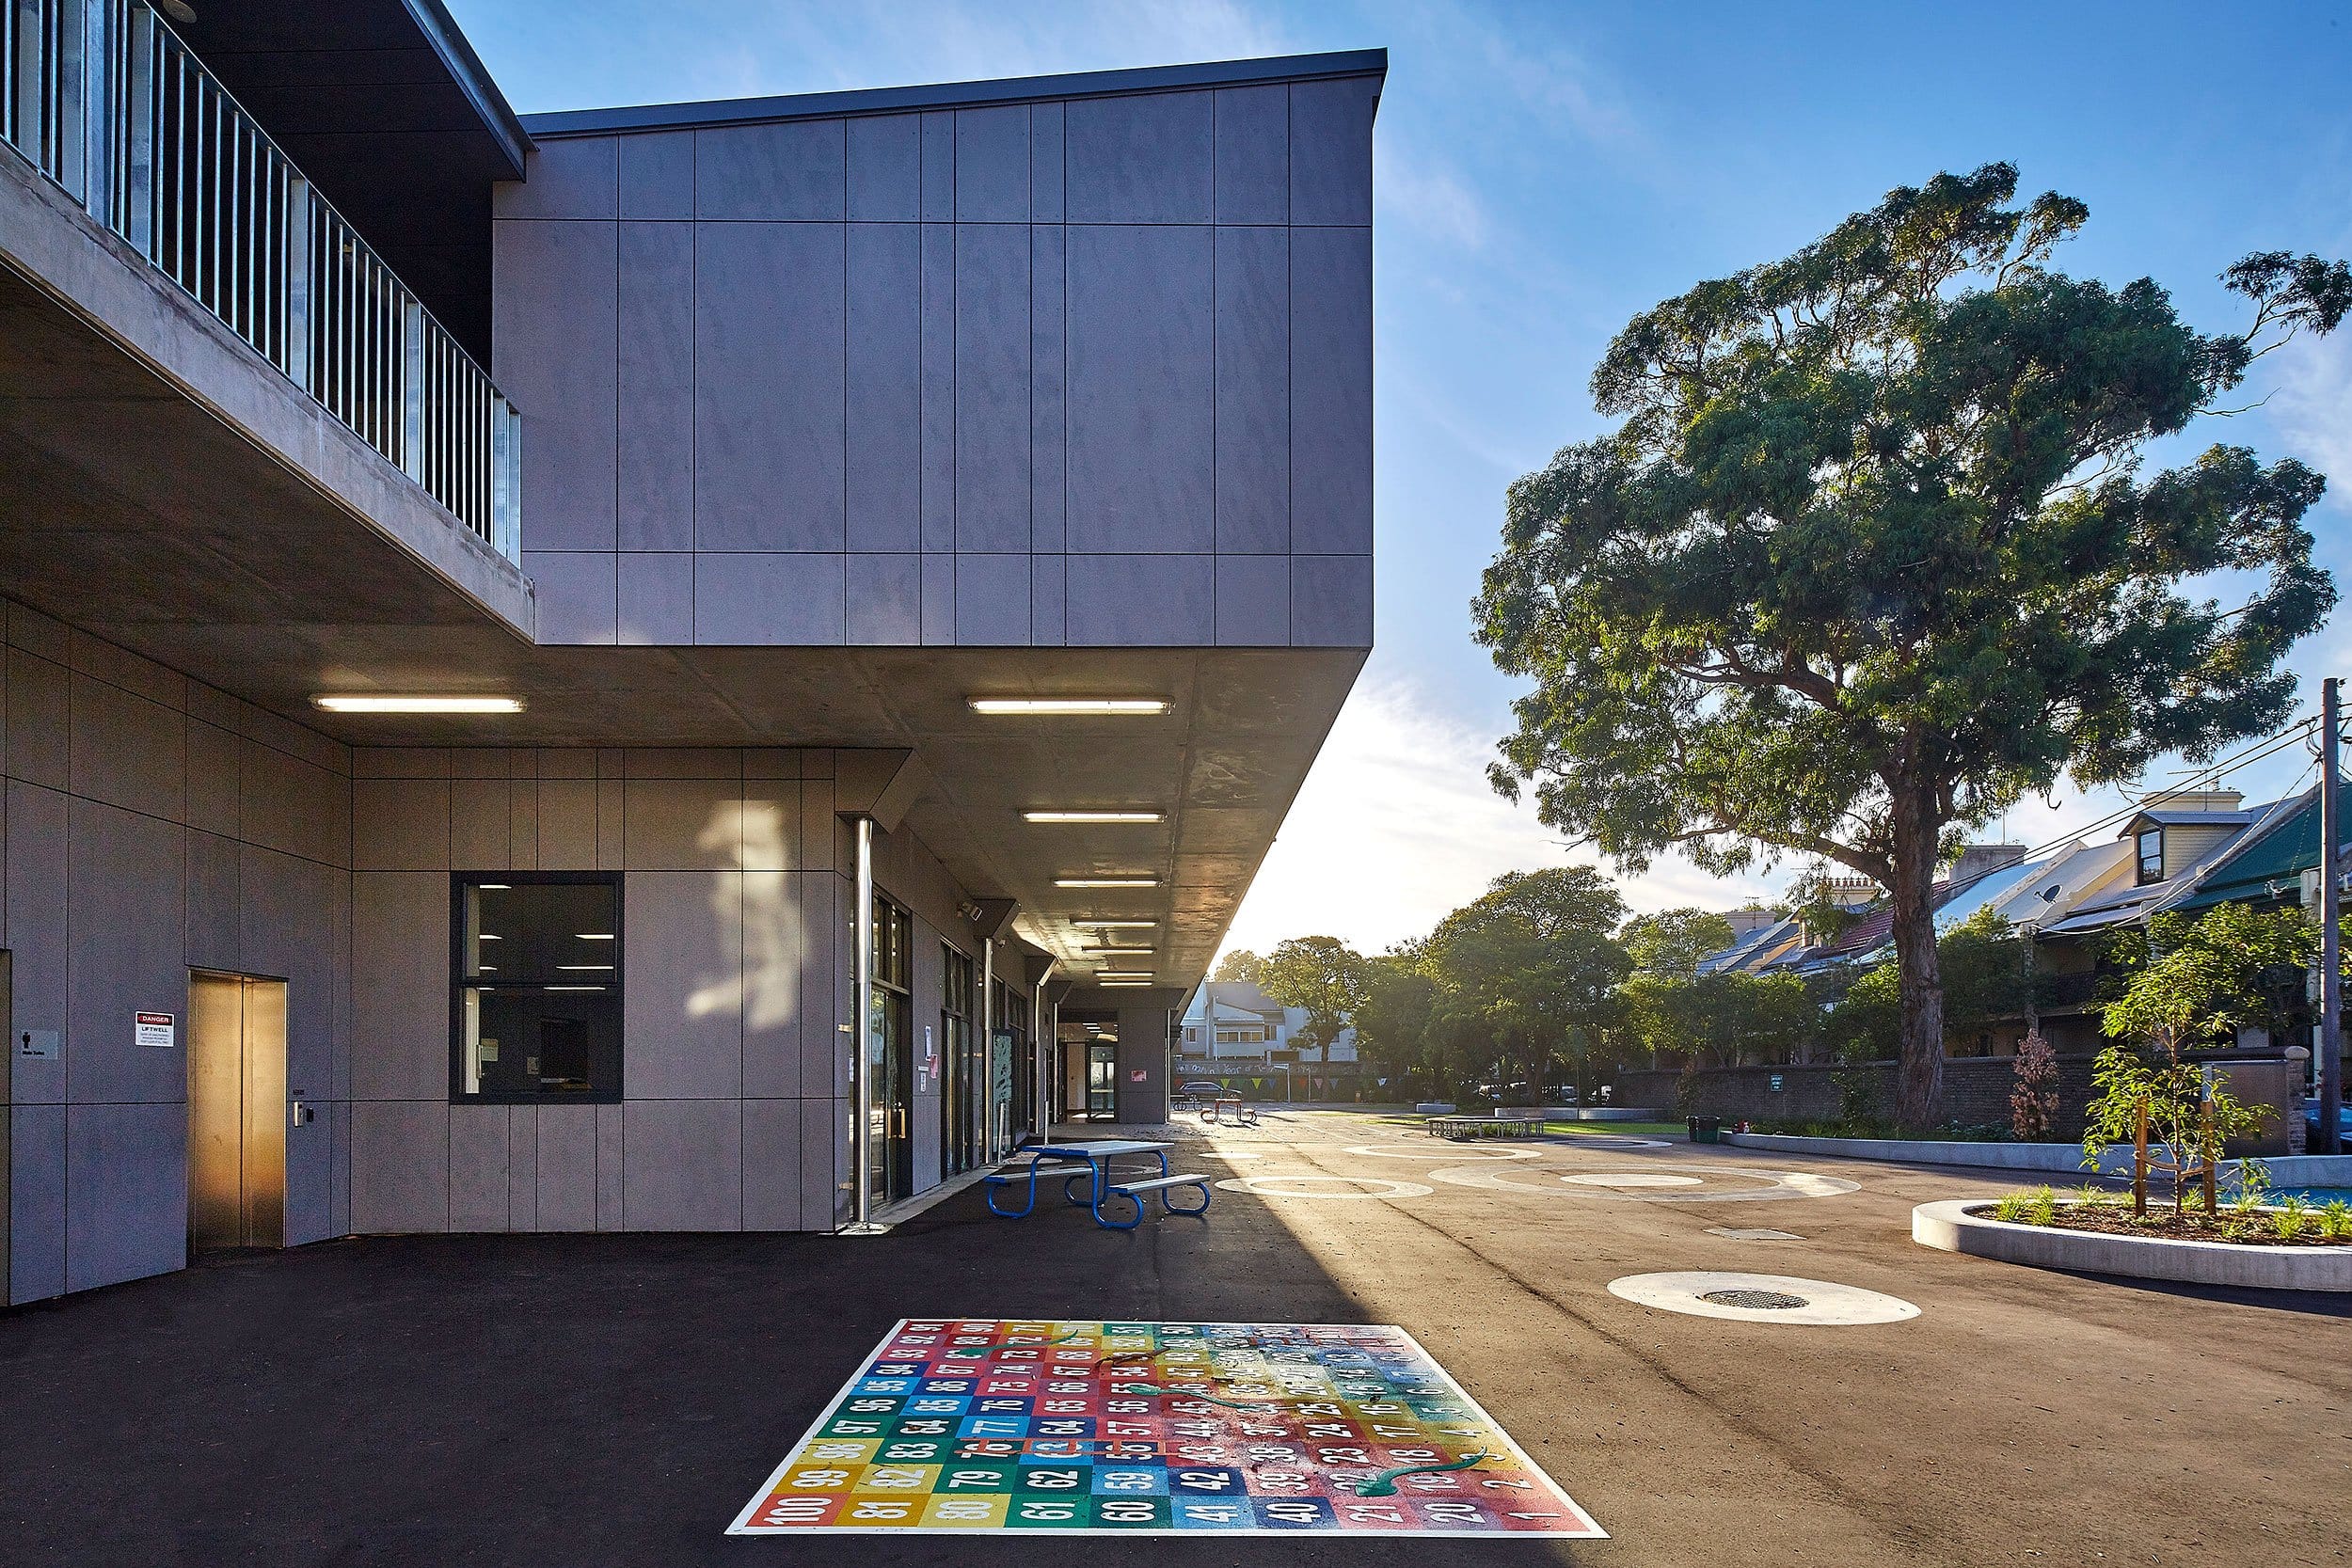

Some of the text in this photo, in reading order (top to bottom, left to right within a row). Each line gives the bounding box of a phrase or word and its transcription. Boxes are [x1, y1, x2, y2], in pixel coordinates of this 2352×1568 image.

[142, 1015, 169, 1023] DANGER
[1161, 1326, 1194, 1335] 50
[899, 1336, 936, 1344] 92
[888, 1350, 928, 1358] 93
[1001, 1351, 1039, 1360] 73
[1164, 1353, 1200, 1361] 48
[875, 1365, 917, 1375] 94
[935, 1365, 975, 1374] 87
[993, 1366, 1033, 1374] 74
[1053, 1366, 1090, 1375] 67
[1111, 1367, 1149, 1377] 54
[1167, 1368, 1204, 1377] 47
[926, 1381, 968, 1392] 86
[988, 1382, 1029, 1392] 75
[1048, 1382, 1089, 1393] 66
[1229, 1384, 1270, 1395] 35
[1287, 1385, 1328, 1396] 26
[1344, 1386, 1387, 1395] 15
[849, 1400, 897, 1411] 96
[914, 1400, 960, 1411] 85
[980, 1400, 1024, 1411] 76
[1044, 1401, 1087, 1412] 65
[1107, 1401, 1149, 1413] 56
[1172, 1402, 1213, 1415] 45
[1296, 1403, 1342, 1416] 25
[1358, 1403, 1402, 1415] 16
[832, 1420, 881, 1433] 97
[899, 1420, 949, 1434] 84
[971, 1420, 1018, 1433] 77
[1038, 1420, 1085, 1434] 64
[1107, 1421, 1152, 1435] 57
[1175, 1422, 1219, 1437] 44
[1241, 1422, 1288, 1437] 37
[1304, 1424, 1353, 1437] 24
[1372, 1424, 1421, 1437] 17
[813, 1443, 866, 1458] 98
[884, 1443, 938, 1458] 83
[961, 1443, 1012, 1458] 78
[1105, 1445, 1152, 1460] 58
[1178, 1445, 1224, 1463] 43
[1248, 1447, 1298, 1462] 38
[1318, 1447, 1371, 1465] 23
[1389, 1449, 1440, 1464] 18
[1459, 1452, 1506, 1461] 3
[791, 1470, 850, 1487] 99
[869, 1469, 926, 1488] 82
[948, 1470, 1003, 1488] 79
[1026, 1470, 1078, 1488] 62
[1104, 1472, 1154, 1490] 59
[1180, 1472, 1230, 1491] 42
[1257, 1473, 1310, 1491] 39
[1407, 1475, 1460, 1492] 19
[1482, 1480, 1534, 1490] 2
[764, 1497, 833, 1525] 100
[851, 1502, 913, 1519] 81
[935, 1501, 993, 1520] 80
[1020, 1502, 1075, 1520] 61
[1101, 1501, 1155, 1522] 60
[1184, 1505, 1238, 1522] 41
[1266, 1503, 1321, 1524] 40
[1346, 1505, 1404, 1524] 21
[1423, 1502, 1486, 1524] 20
[1508, 1511, 1561, 1519] 1
